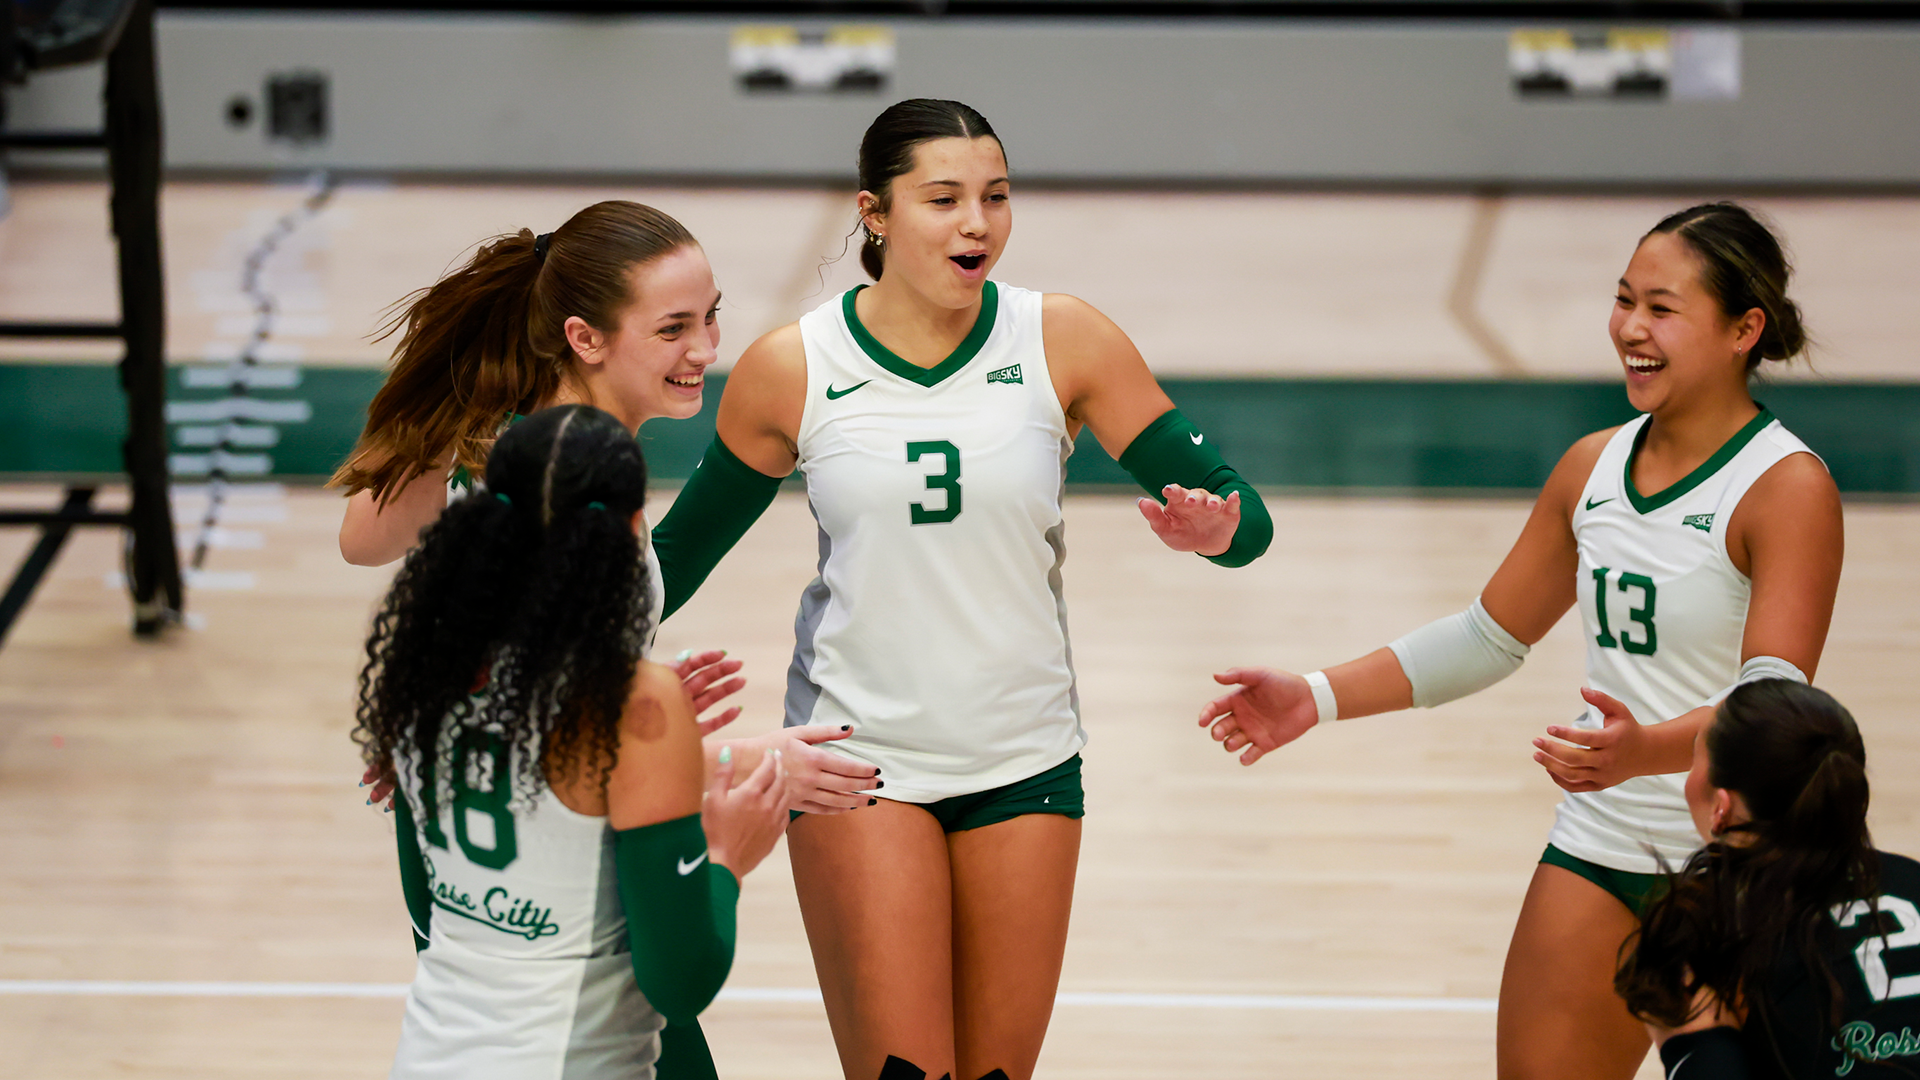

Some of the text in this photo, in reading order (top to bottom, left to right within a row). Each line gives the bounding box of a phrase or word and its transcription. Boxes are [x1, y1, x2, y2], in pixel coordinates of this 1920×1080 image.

[905, 439, 963, 526] 3
[1593, 567, 1657, 657] 13
[484, 886, 559, 940] City
[1831, 1021, 1920, 1077] Ros
